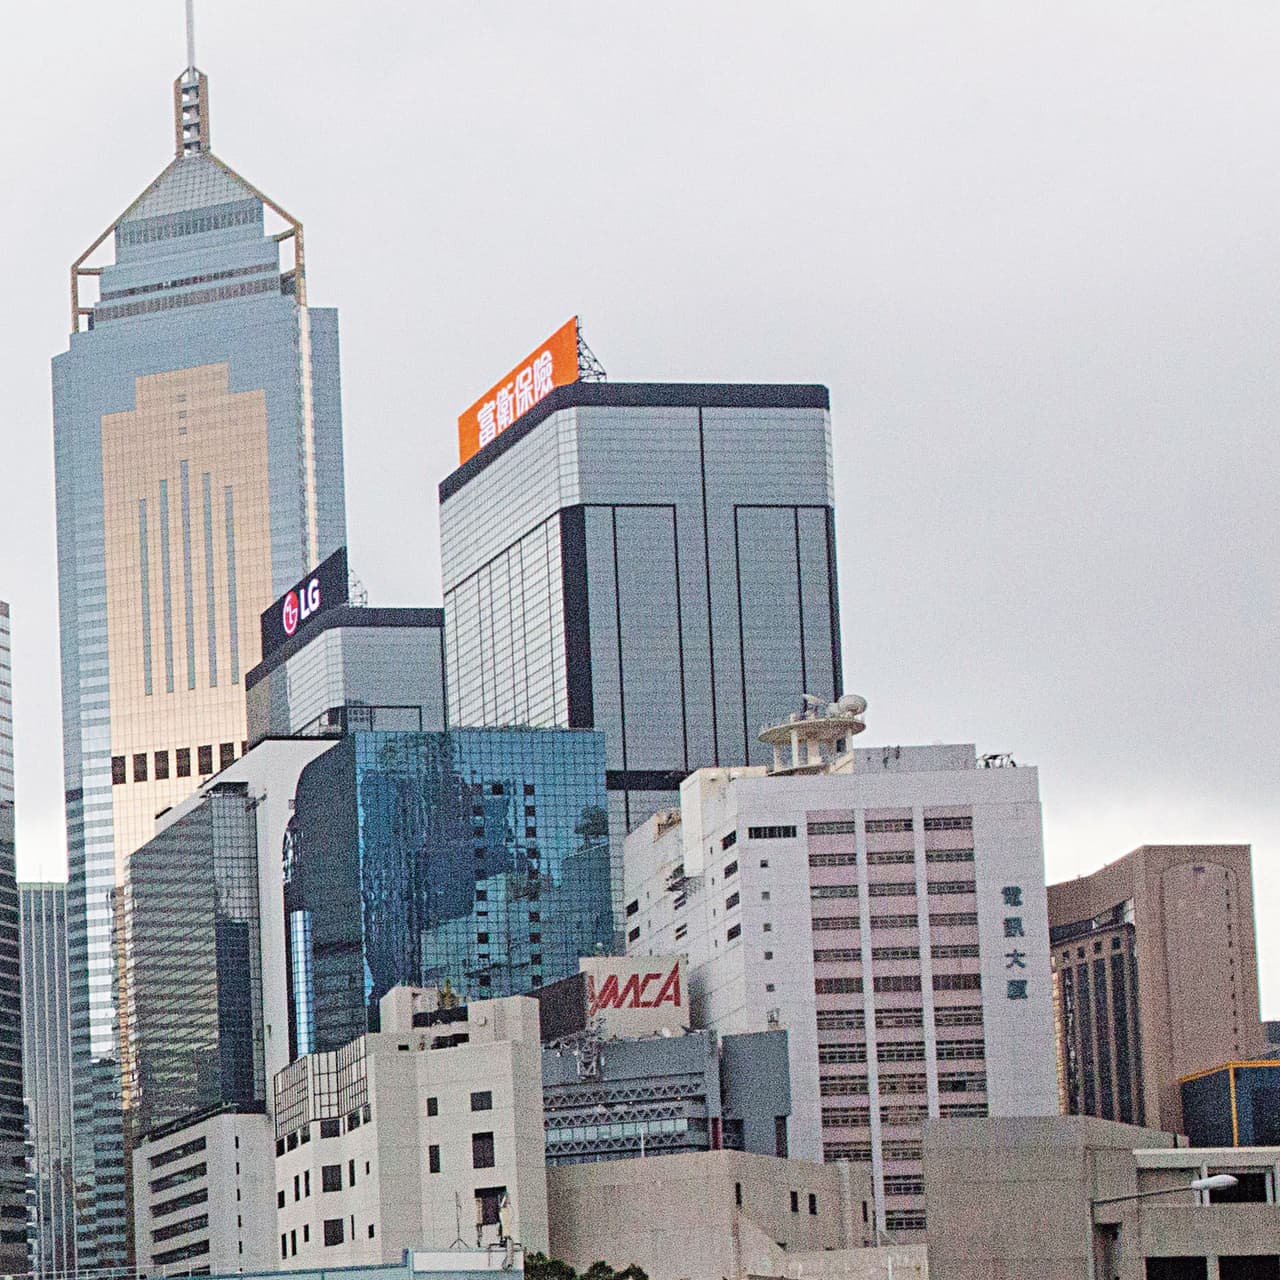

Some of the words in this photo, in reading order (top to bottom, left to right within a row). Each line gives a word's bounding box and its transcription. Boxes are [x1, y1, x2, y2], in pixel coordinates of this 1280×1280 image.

[477, 350, 554, 448] 富衛保險
[300, 578, 320, 620] LG
[588, 961, 681, 1017] YMCA
